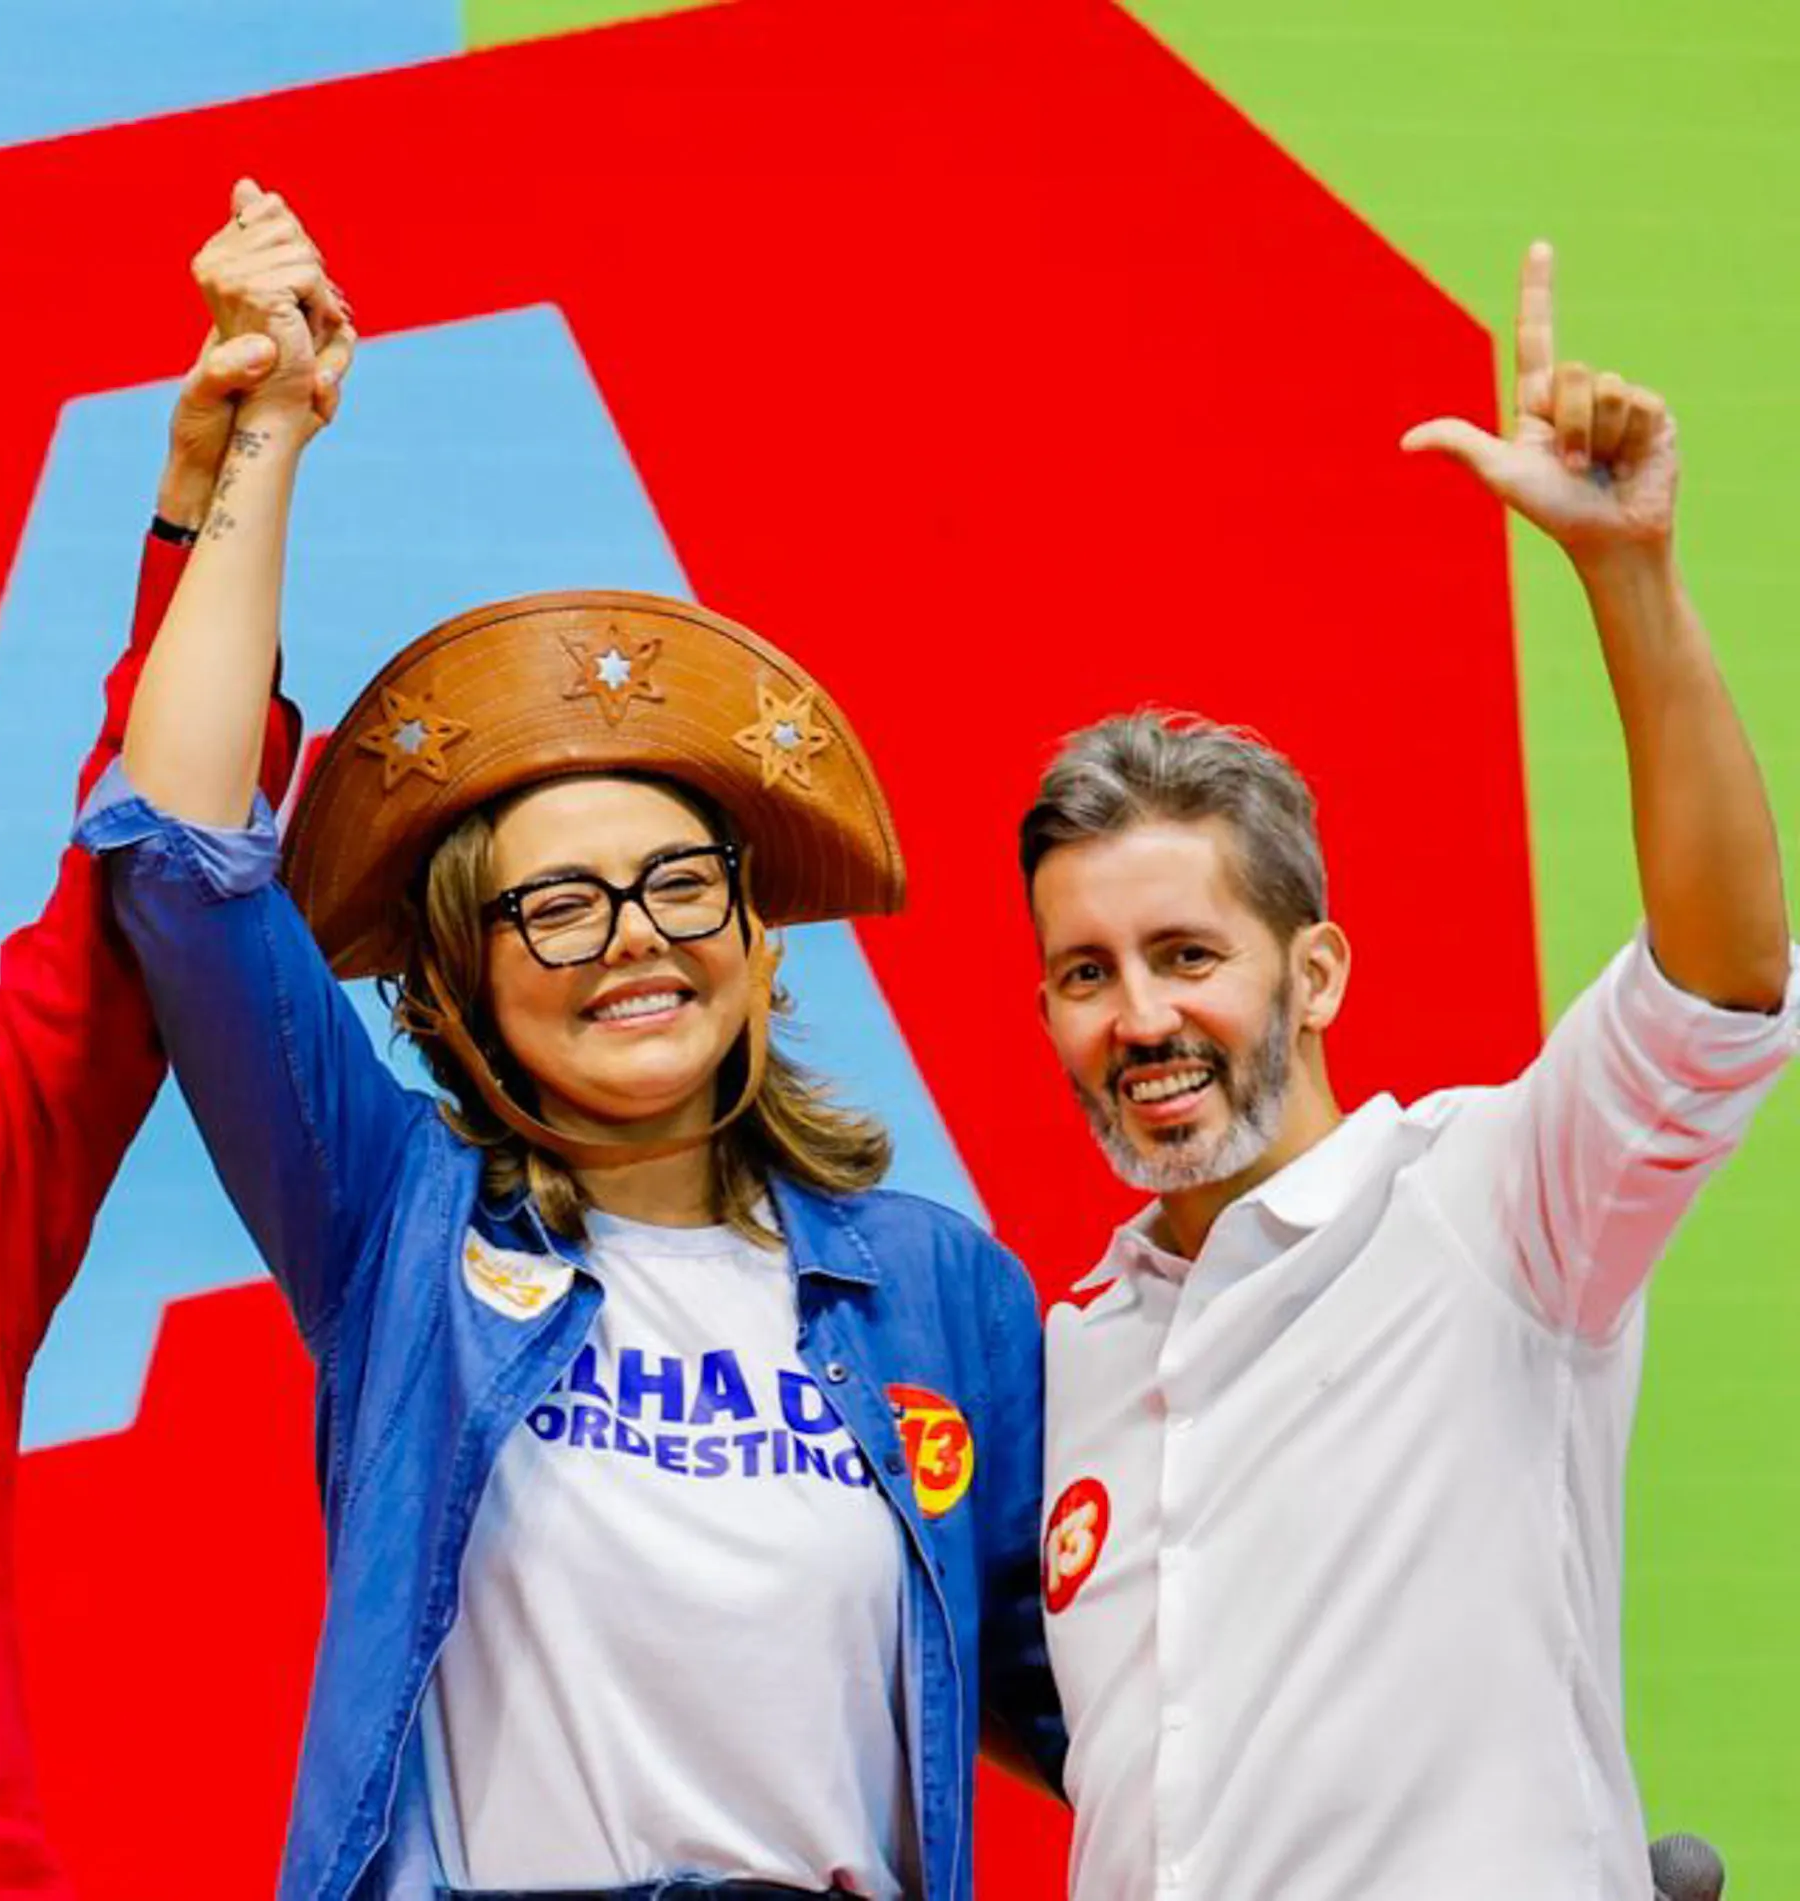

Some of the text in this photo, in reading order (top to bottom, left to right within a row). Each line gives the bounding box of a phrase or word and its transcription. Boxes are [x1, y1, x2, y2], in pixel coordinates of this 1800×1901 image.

[550, 1343, 756, 1425] LHA
[899, 1418, 969, 1491] 13
[1047, 1501, 1098, 1593] 13
